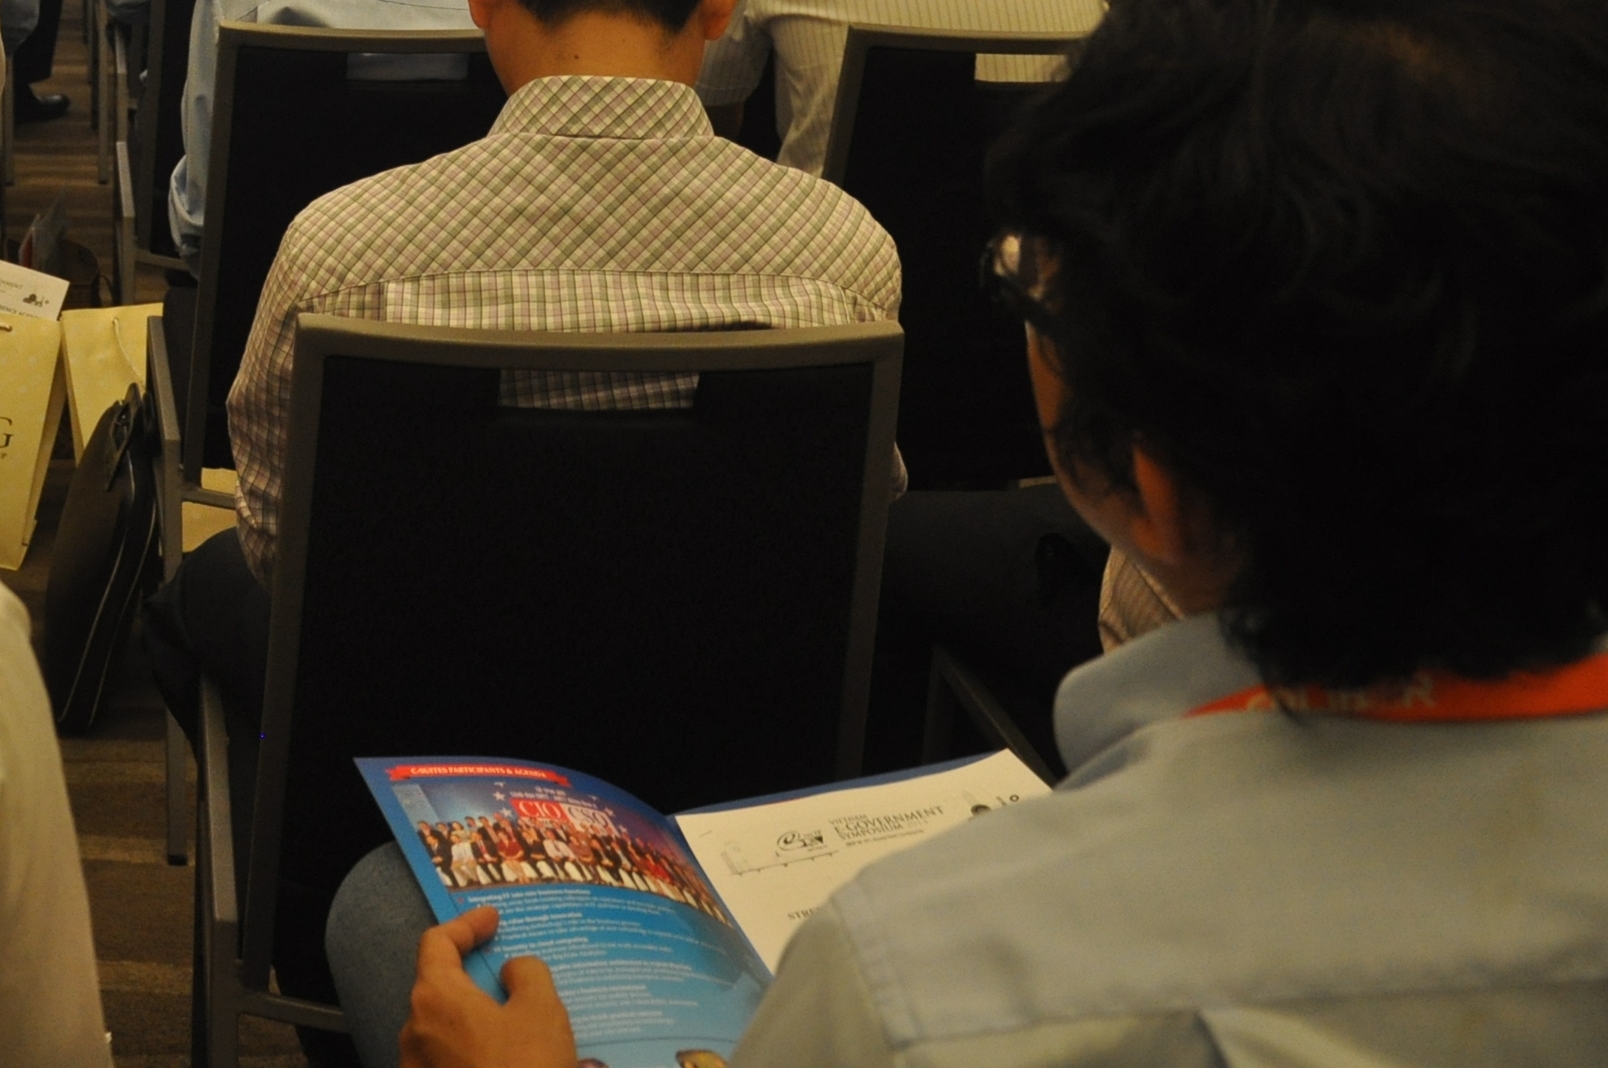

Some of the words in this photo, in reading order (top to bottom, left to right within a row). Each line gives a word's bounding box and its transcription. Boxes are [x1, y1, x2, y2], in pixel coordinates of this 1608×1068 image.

[410, 766, 448, 775] C-SUITES
[448, 766, 506, 775] PARTICIPANTS
[514, 768, 546, 778] AGENDA
[518, 800, 561, 820] CIO
[834, 804, 944, 834] E-GOVERNMENT
[838, 822, 904, 841] SYMPOSIUM
